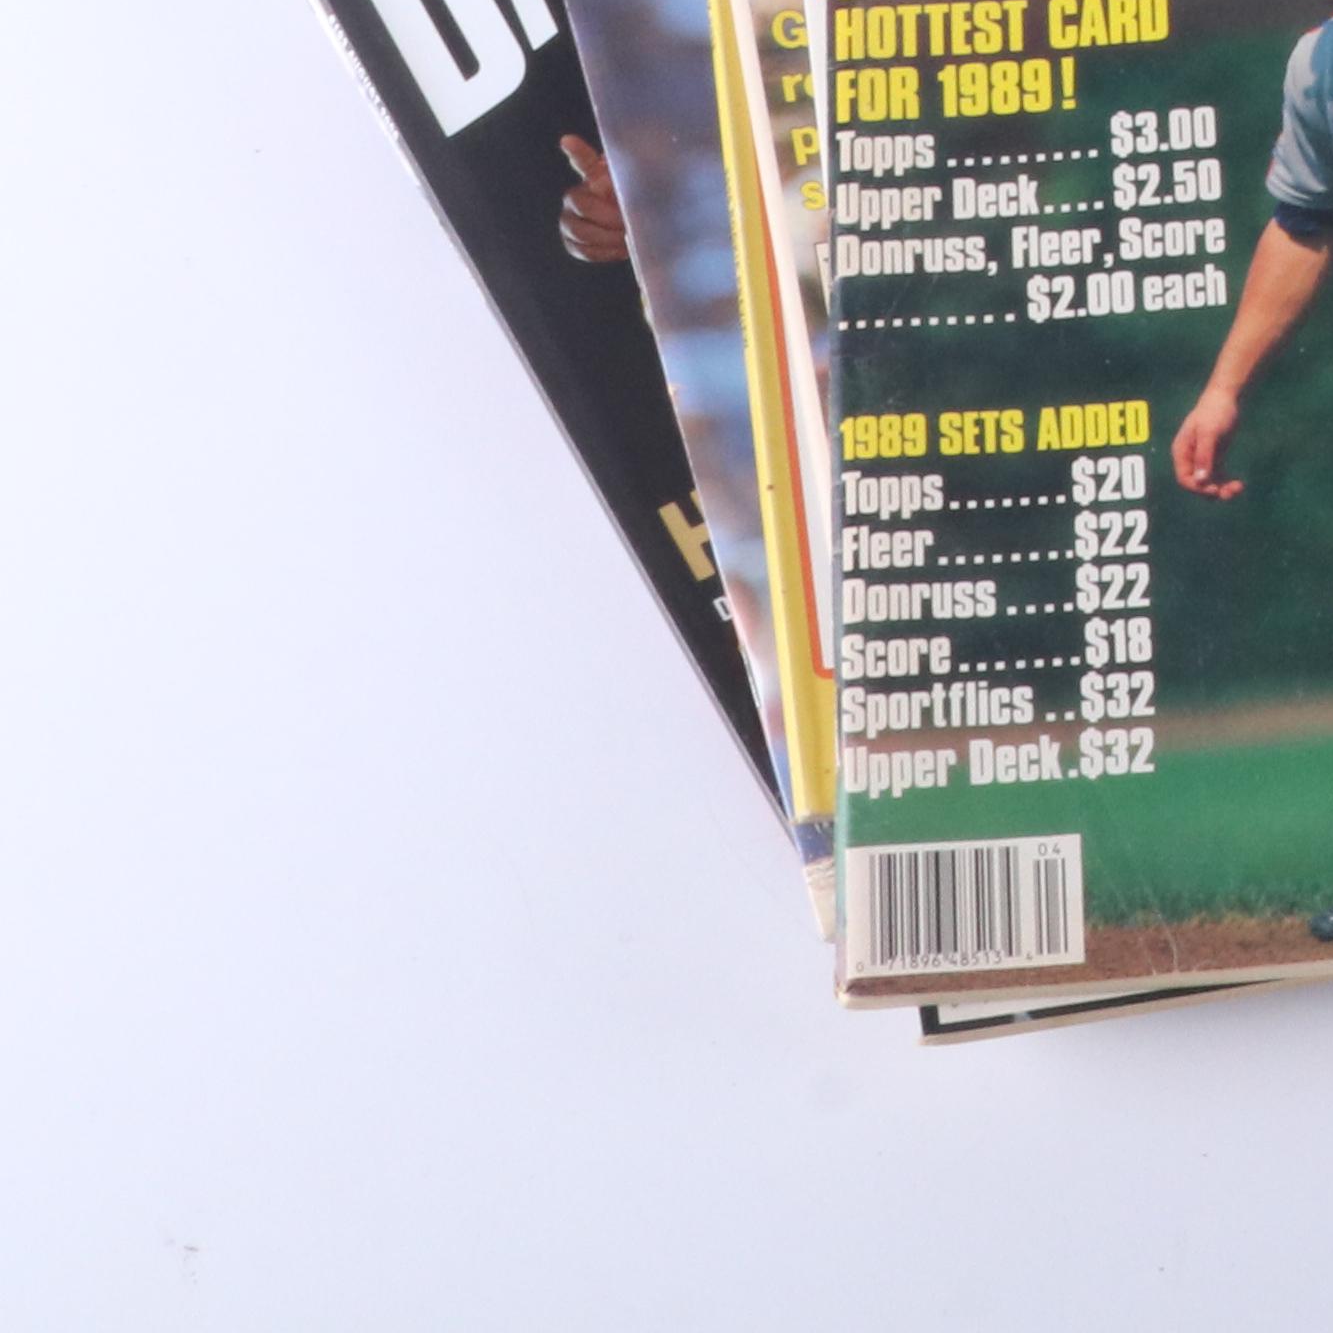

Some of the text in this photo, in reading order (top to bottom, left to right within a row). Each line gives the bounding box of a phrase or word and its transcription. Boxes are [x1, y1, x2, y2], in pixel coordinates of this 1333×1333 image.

[834, 0, 1028, 62] HOTTEST
[835, 65, 921, 124] FOR
[836, 130, 936, 177] Topps
[1109, 105, 1218, 159] $3.00
[836, 182, 943, 232] Upper
[1112, 158, 1223, 211] $2.50
[836, 233, 998, 278] Donruss,
[1118, 216, 1227, 262] Score
[1026, 263, 1228, 324] $2.00 each
[840, 399, 1151, 461] 1989 SETS ADDED
[841, 454, 1148, 521] Topps $20
[842, 509, 1150, 573] Fleer $22
[842, 562, 1152, 625] Donruss $22
[842, 616, 1154, 681] Score $18
[842, 670, 1156, 740] Sportflics $32
[844, 746, 958, 800] Upper
[1079, 727, 1156, 781] $32
[1037, 842, 1062, 857] 04
